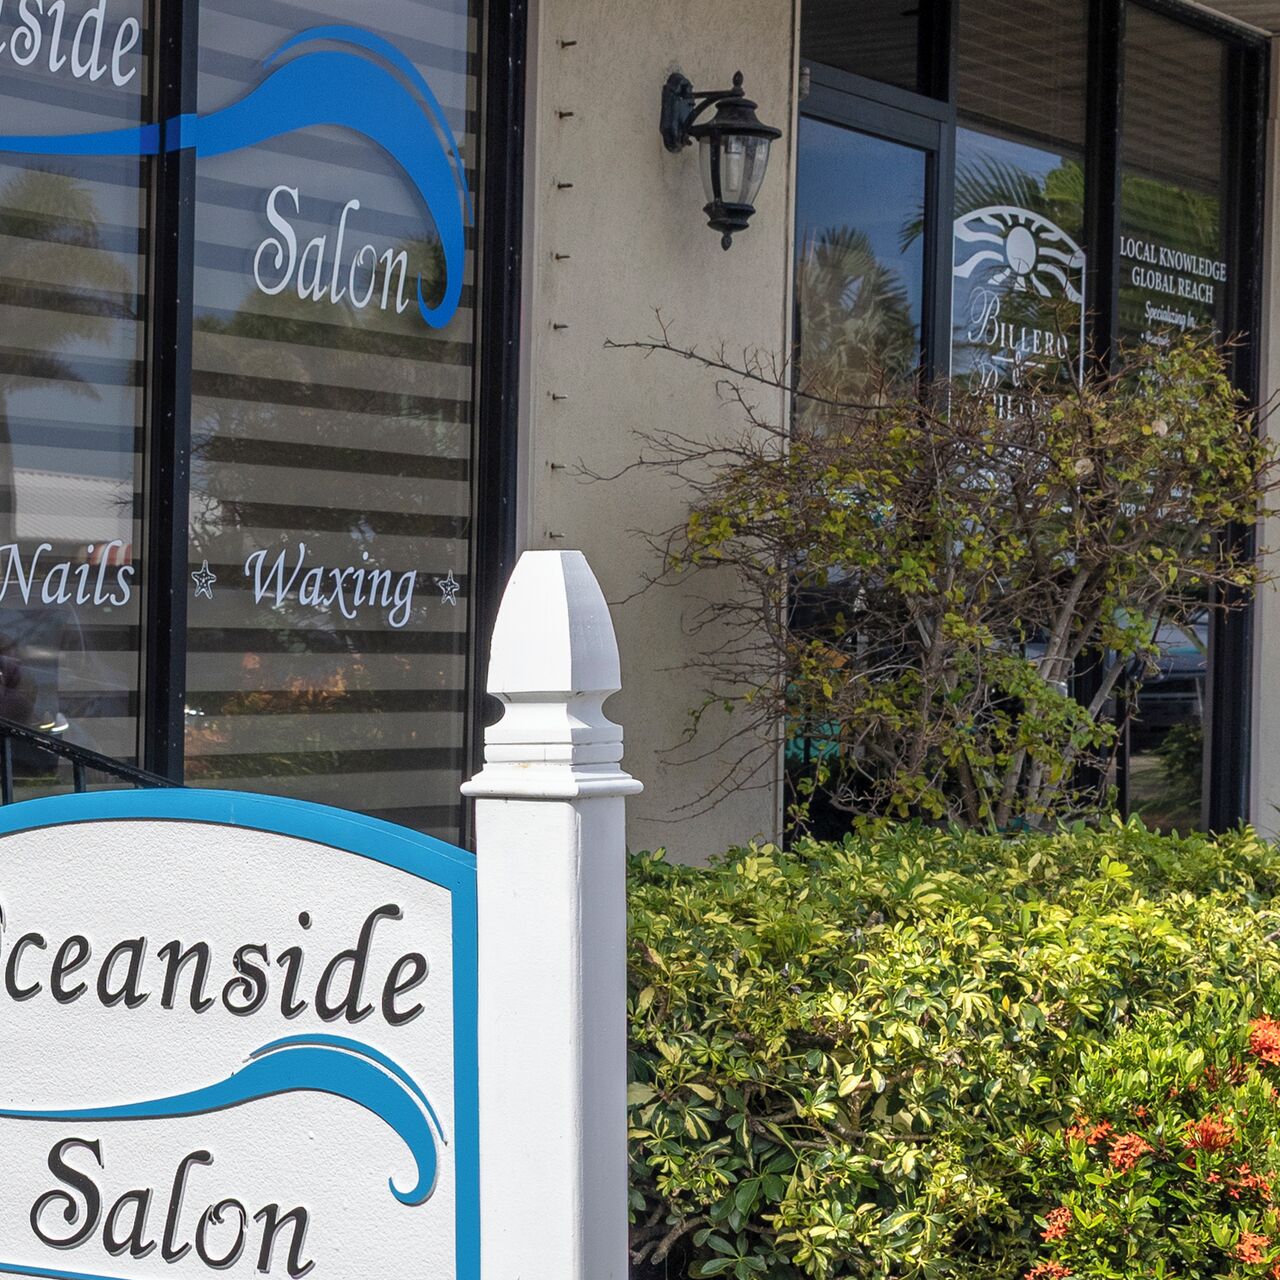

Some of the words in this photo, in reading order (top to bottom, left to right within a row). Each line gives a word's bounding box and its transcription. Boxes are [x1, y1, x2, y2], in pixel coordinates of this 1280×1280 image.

[253, 185, 410, 314] Salon
[1119, 235, 1158, 264] LOCAL
[1159, 246, 1228, 282] KNOWLEDGE
[1131, 266, 1177, 294] GLOBAL
[1177, 277, 1215, 304] REACH
[244, 542, 419, 629] Waxing
[29, 1137, 317, 1280] Salon
